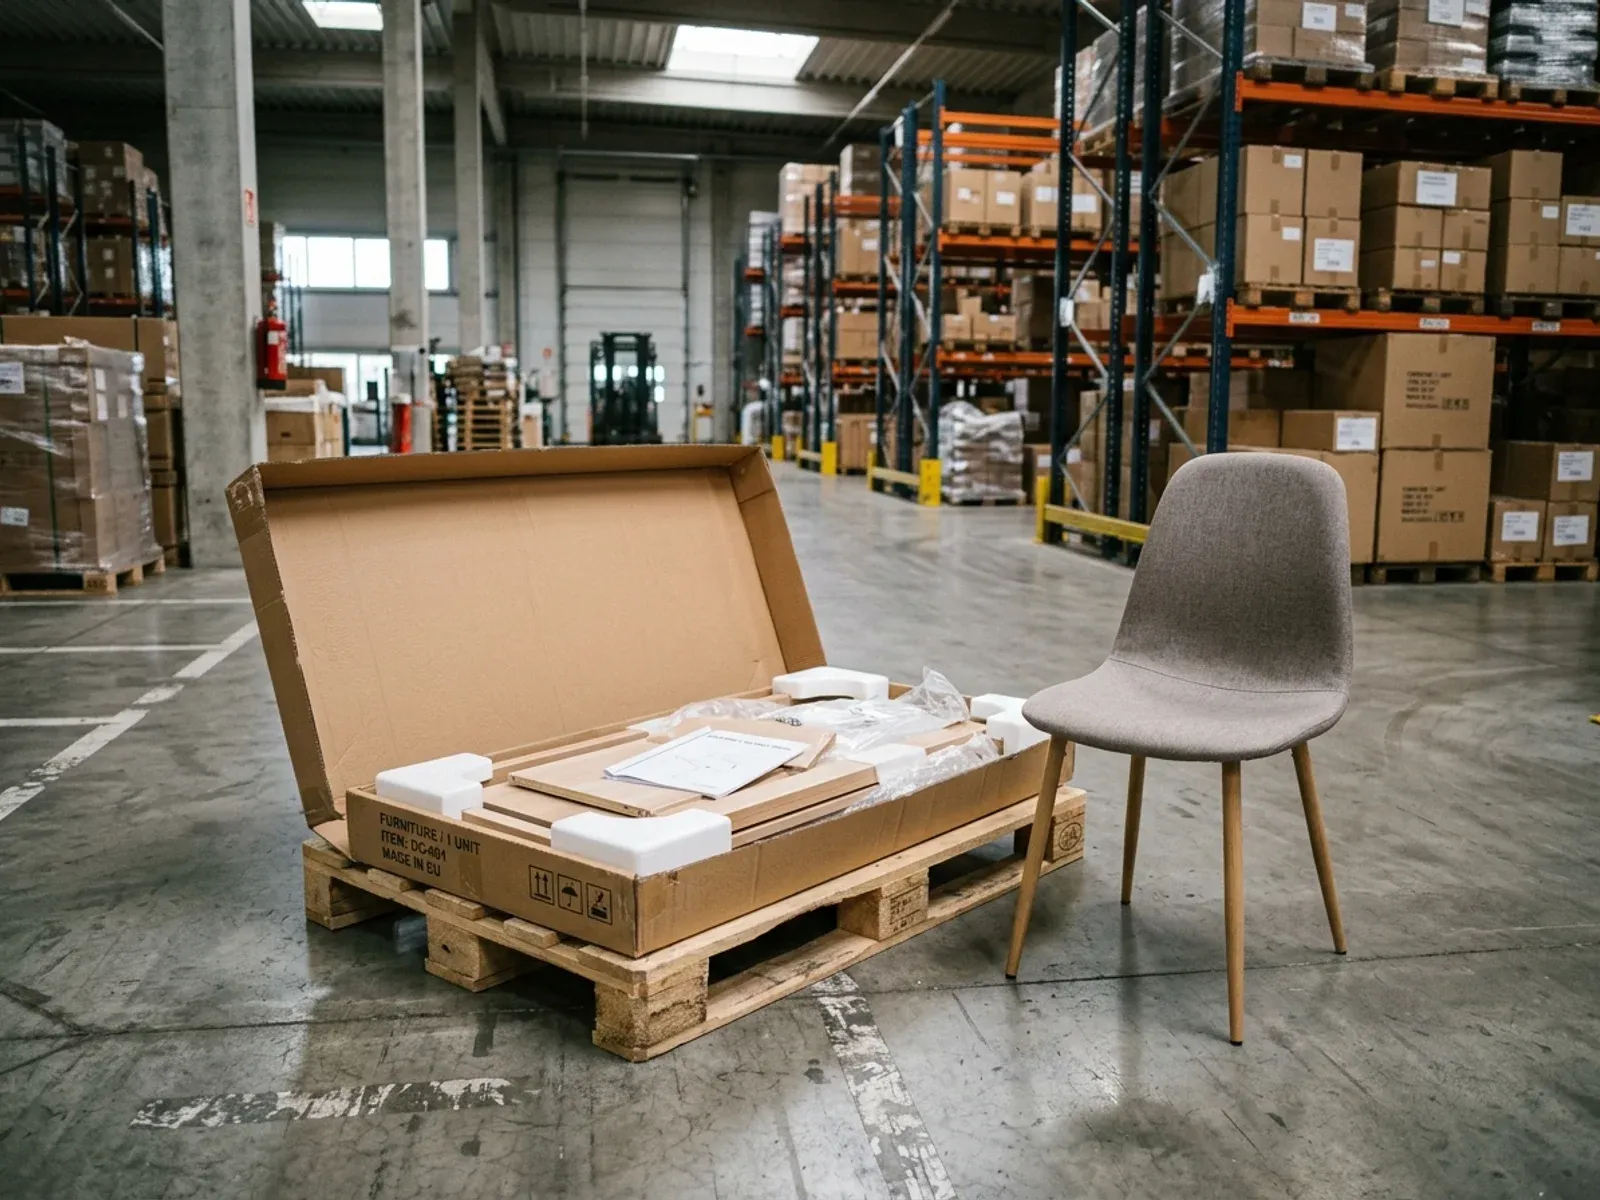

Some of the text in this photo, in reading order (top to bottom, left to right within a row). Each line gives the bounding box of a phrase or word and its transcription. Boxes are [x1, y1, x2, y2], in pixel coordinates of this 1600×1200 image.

[380, 813, 438, 842] FURNITURE
[454, 837, 481, 855] UNIT
[413, 856, 424, 871] IN
[426, 861, 441, 877] EU
